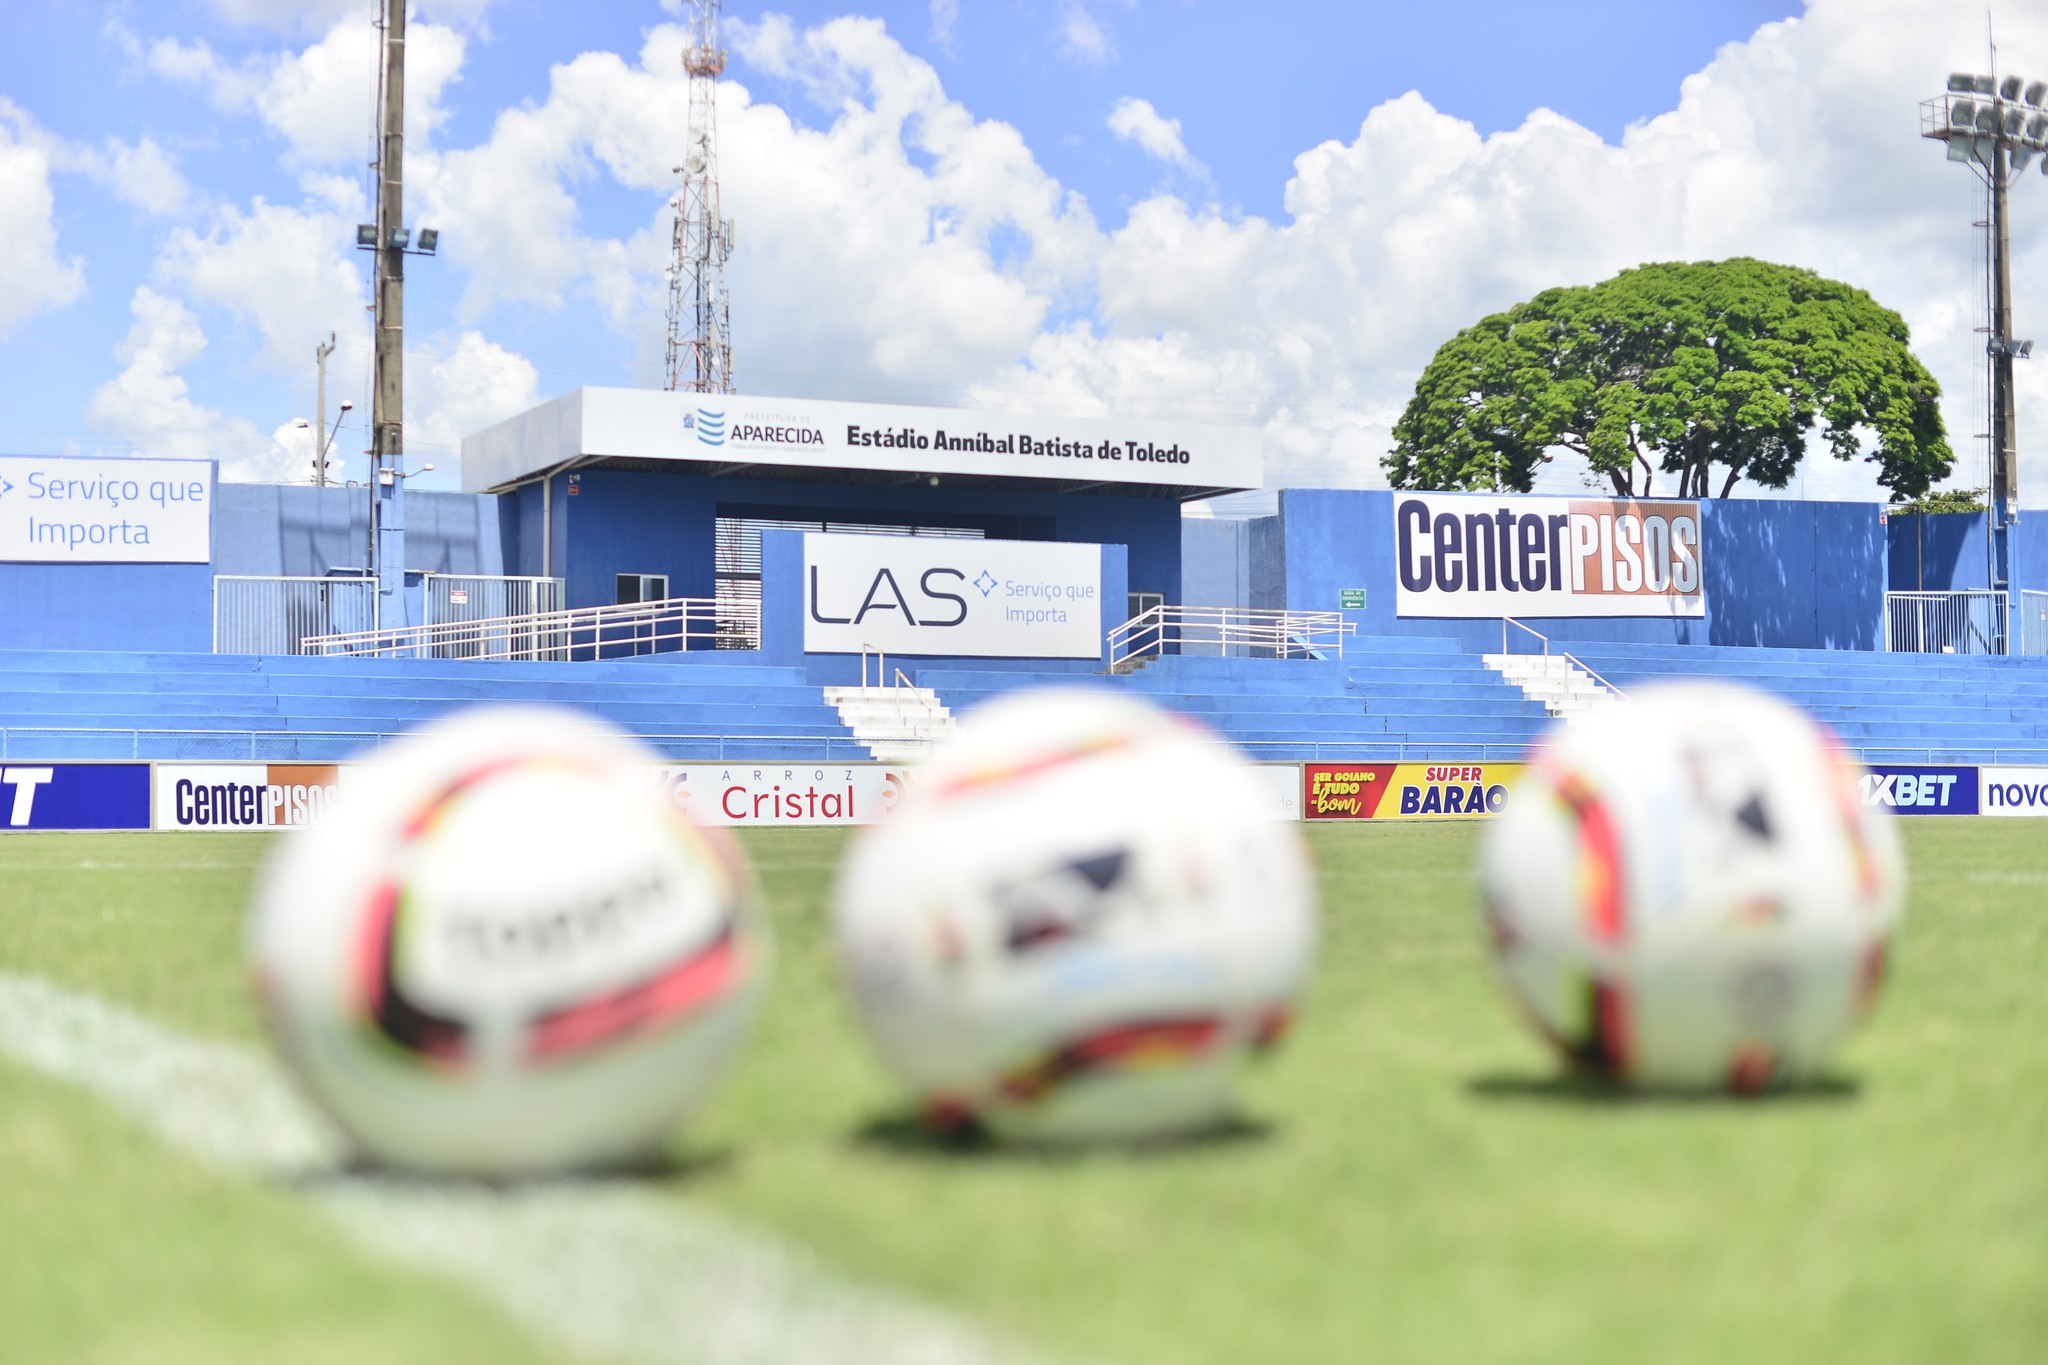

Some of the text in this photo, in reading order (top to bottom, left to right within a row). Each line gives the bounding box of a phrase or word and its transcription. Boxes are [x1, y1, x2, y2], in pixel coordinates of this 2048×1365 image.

[730, 425, 825, 445] APARECIDA
[847, 425, 929, 450] Estádio
[934, 430, 1015, 455] Anníbal
[1019, 435, 1094, 459] Batista
[1098, 440, 1122, 460] de
[1125, 441, 1191, 465] Toledo
[28, 472, 204, 509] Serviço que
[30, 516, 150, 551] Importa
[810, 565, 968, 627] LAS
[1005, 580, 1094, 602] Serviço que
[1005, 606, 1067, 626] Importa
[1313, 772, 1376, 782] SER GOIANO
[1324, 783, 1360, 795] TUDO
[1426, 766, 1483, 782] SUPER
[1857, 774, 1958, 807] 1XBET
[0, 767, 54, 827] T
[722, 785, 854, 819] Cristal
[1317, 788, 1362, 815] bom
[1400, 782, 1509, 815] BARÃO
